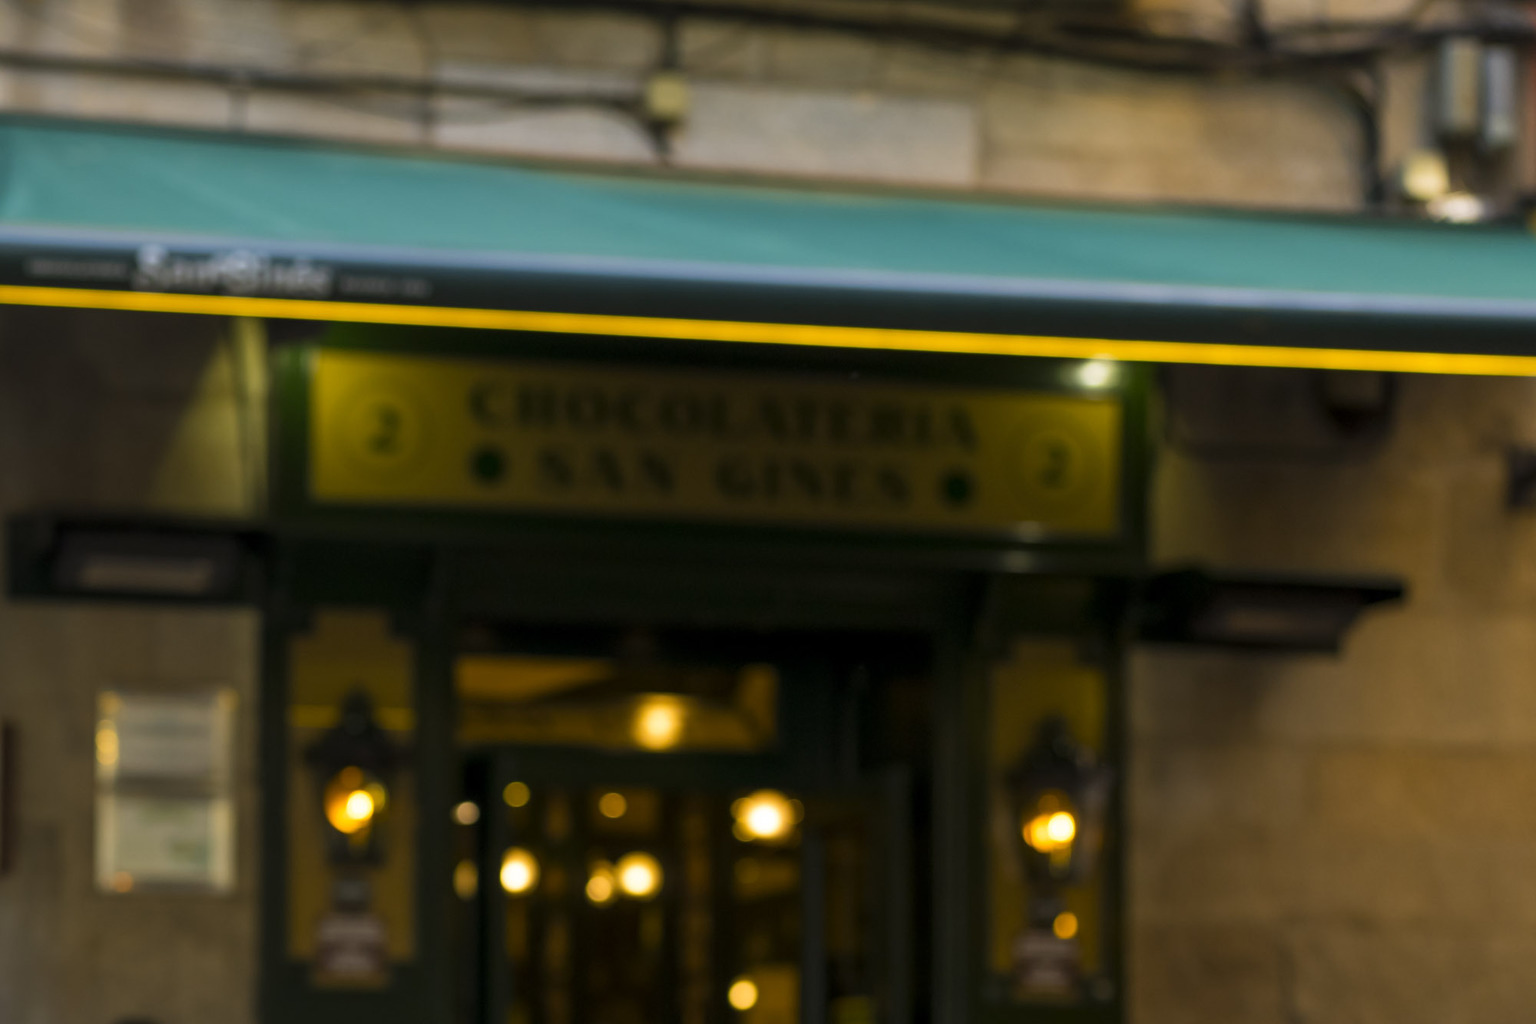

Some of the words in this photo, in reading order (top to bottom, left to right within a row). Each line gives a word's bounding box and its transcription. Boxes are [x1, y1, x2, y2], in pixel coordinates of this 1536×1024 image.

[366, 402, 403, 455] 2
[467, 380, 979, 454] CHOCOLATERIA
[537, 448, 677, 494] SAN
